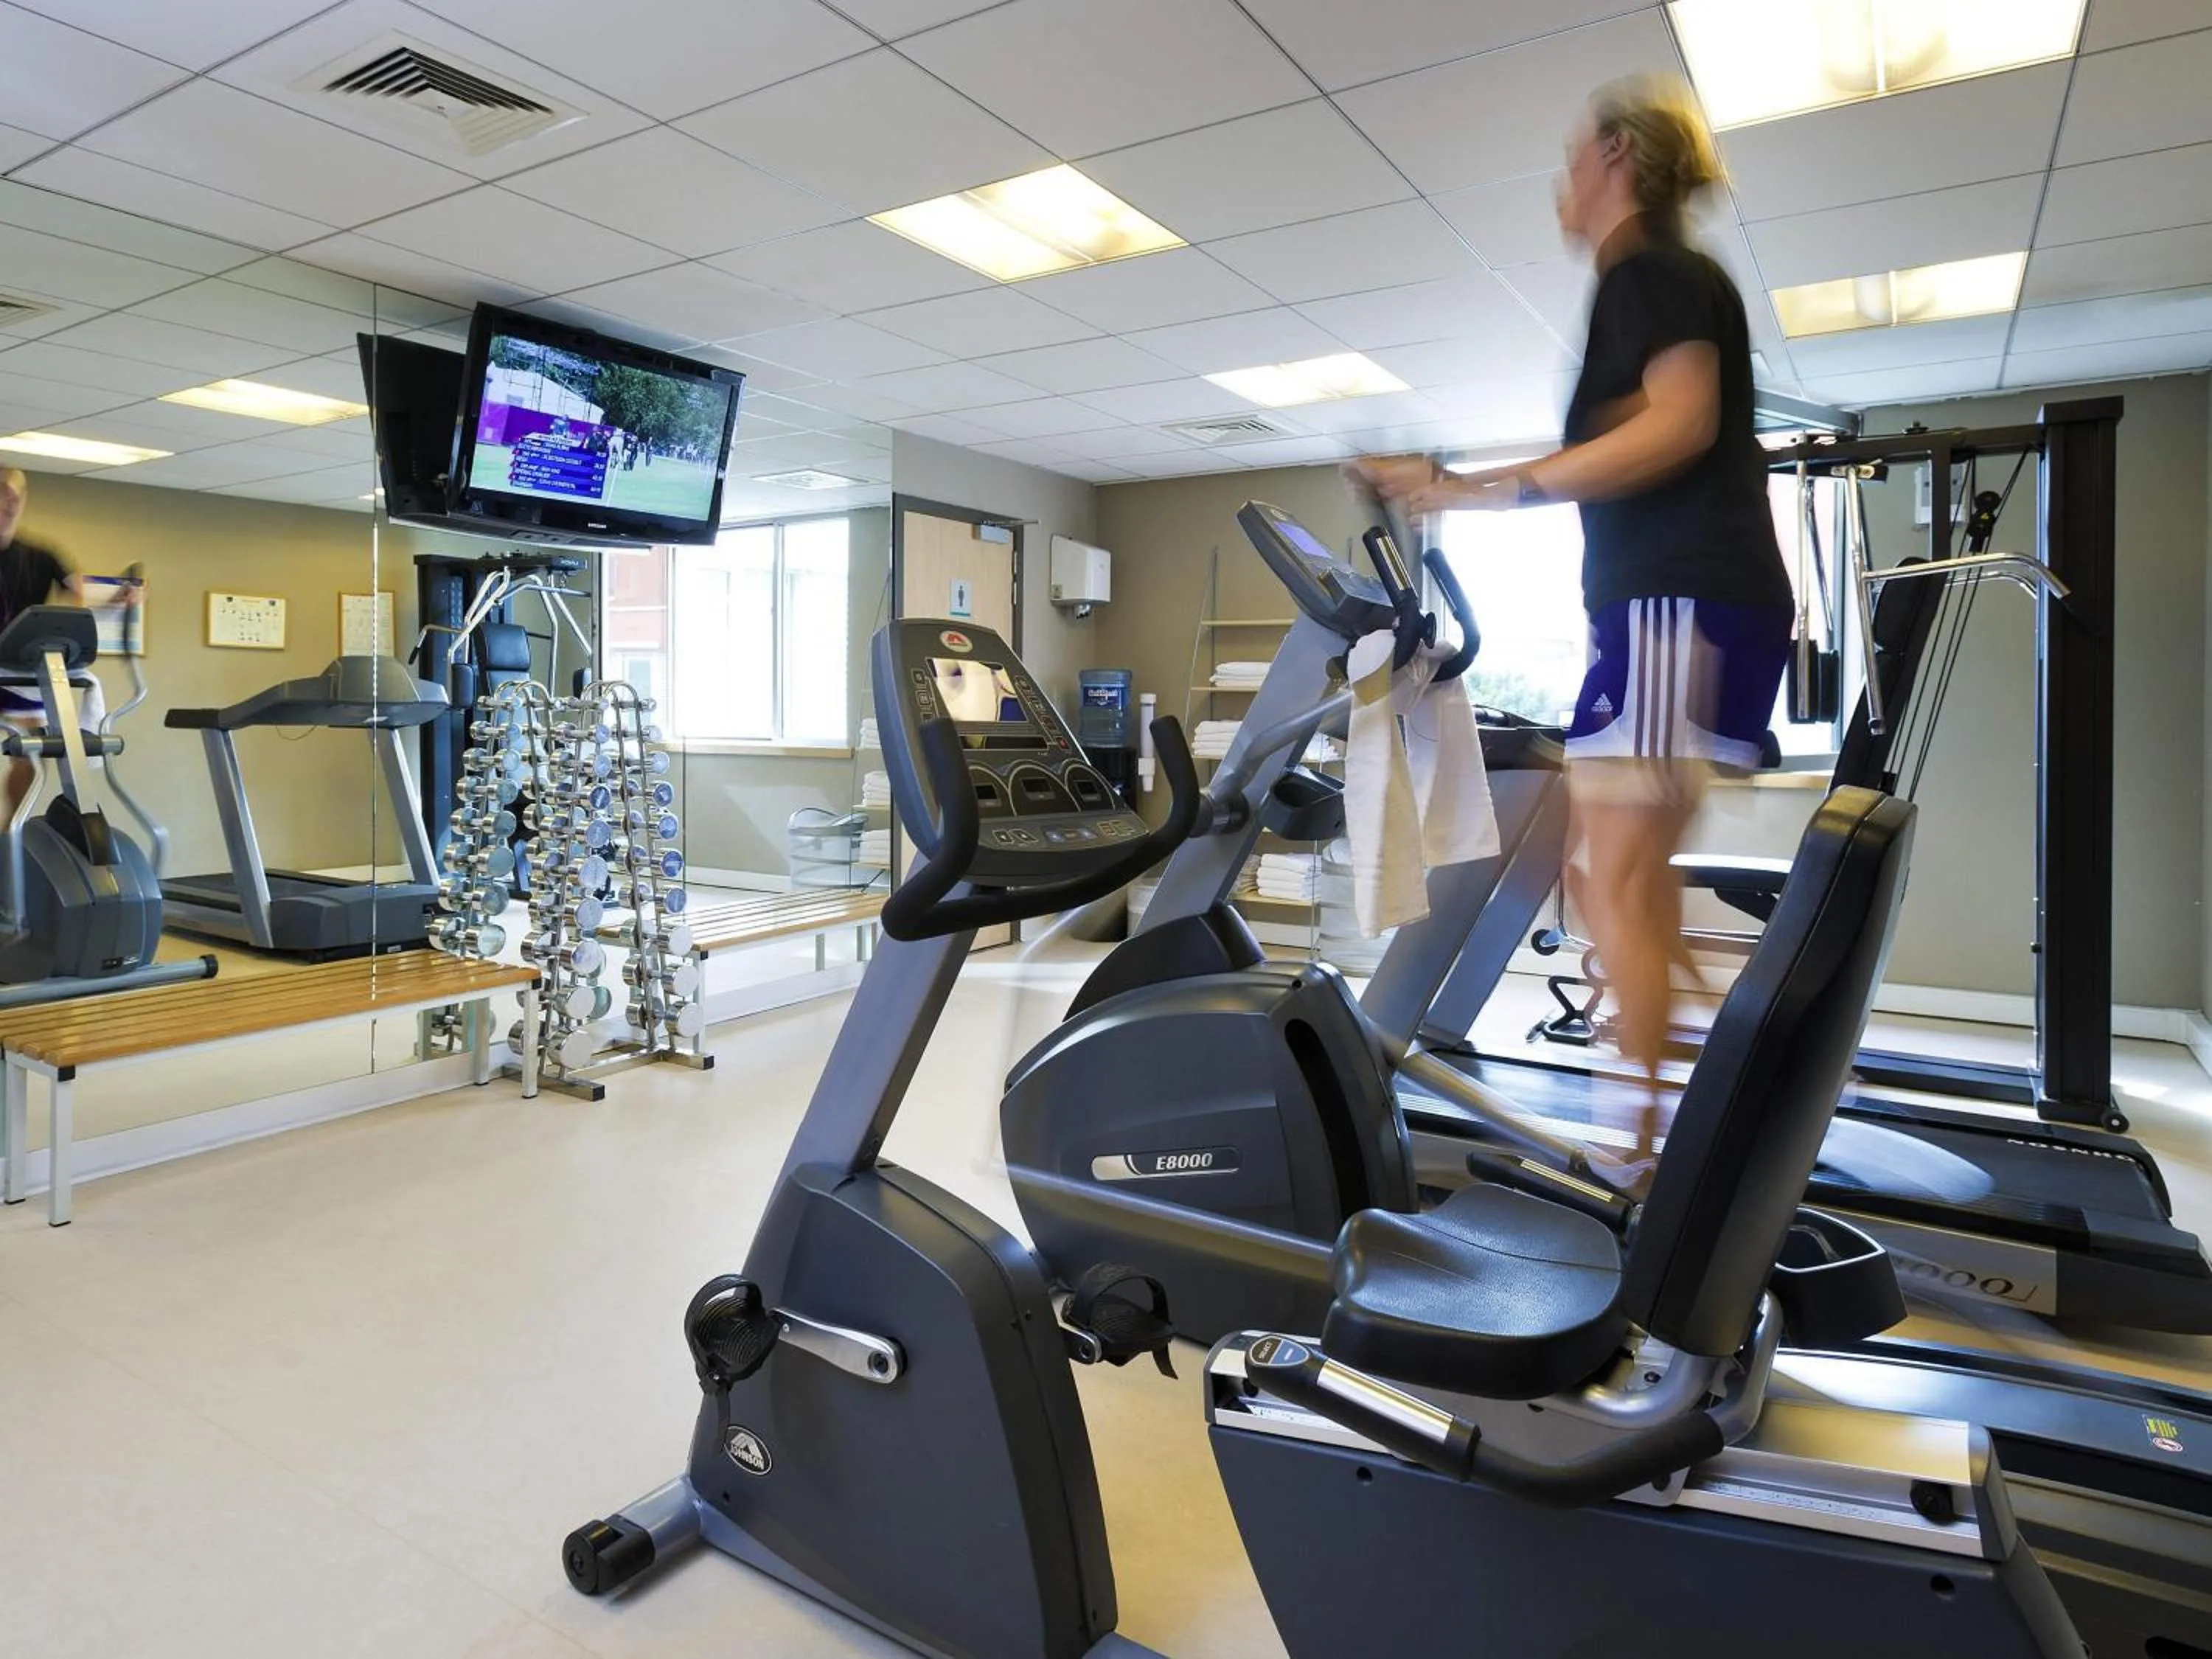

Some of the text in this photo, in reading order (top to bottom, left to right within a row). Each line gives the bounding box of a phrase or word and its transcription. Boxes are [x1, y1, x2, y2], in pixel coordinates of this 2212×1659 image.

[1156, 1153, 1213, 1169] E8000
[2006, 1138, 2137, 1163] OHNSON
[730, 1443, 765, 1470] JOHNSON
